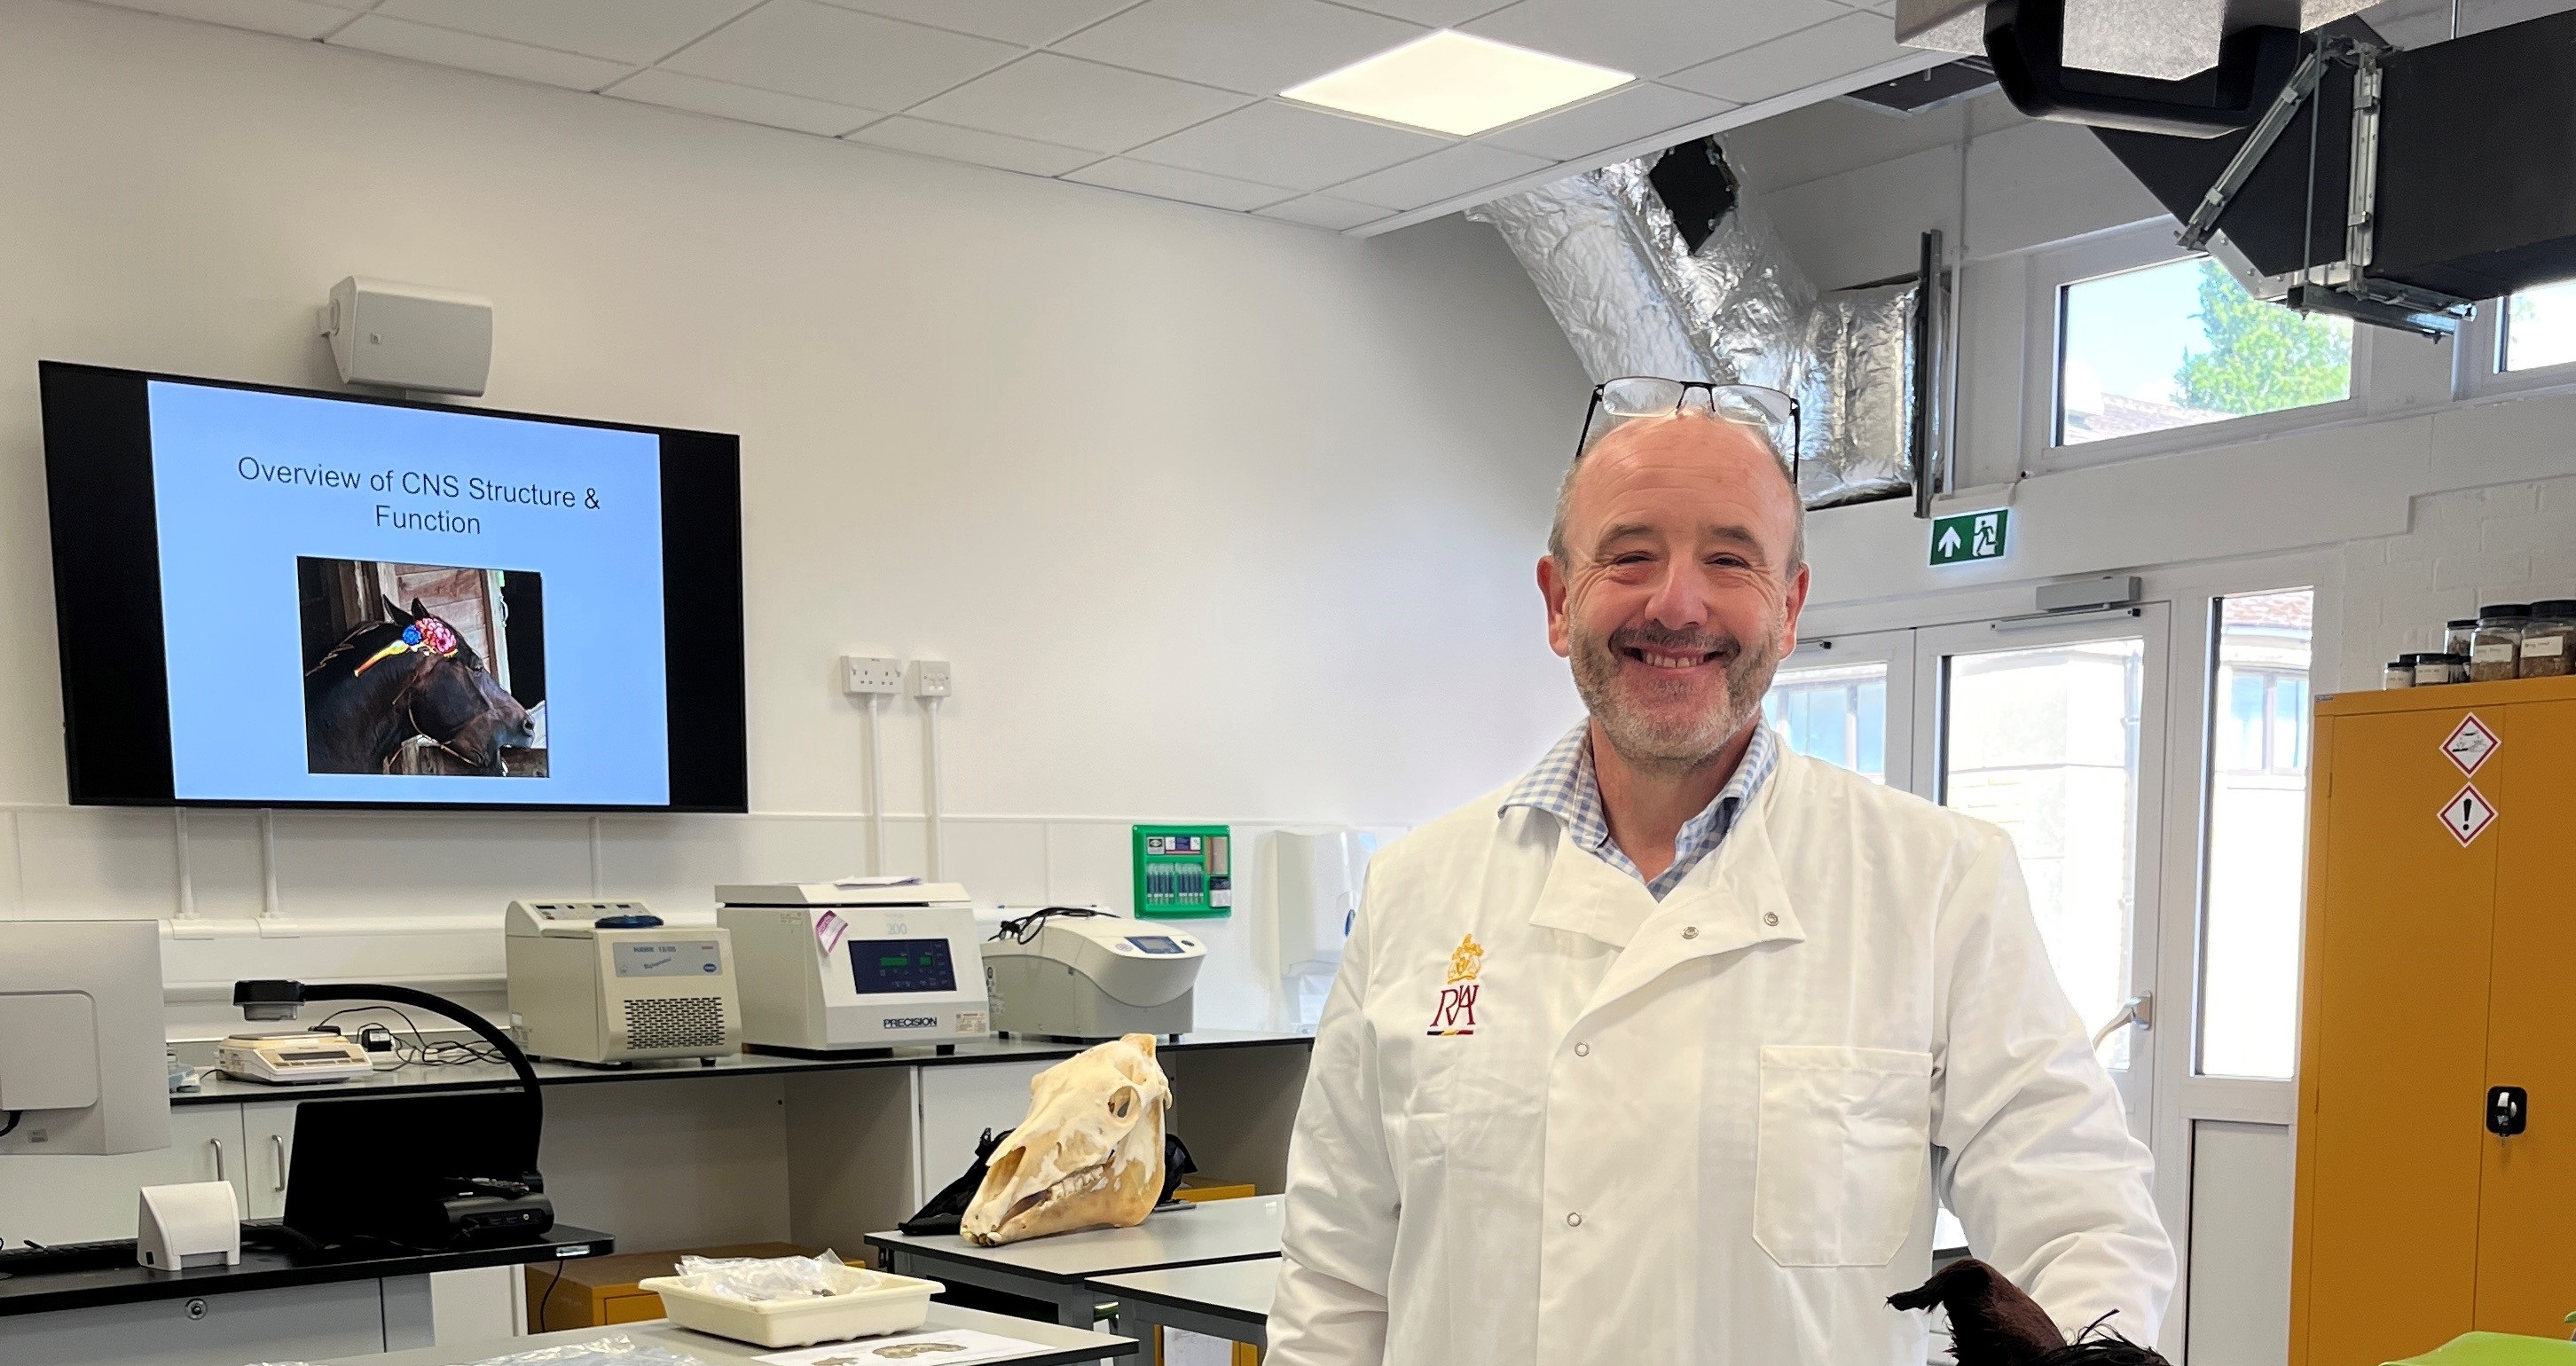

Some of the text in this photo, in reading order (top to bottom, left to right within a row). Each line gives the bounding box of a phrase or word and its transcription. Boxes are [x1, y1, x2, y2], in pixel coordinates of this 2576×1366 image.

[237, 456, 601, 511] Overview of CNS Structure &
[375, 504, 481, 535] Function
[884, 1017, 938, 1029] PRECISION
